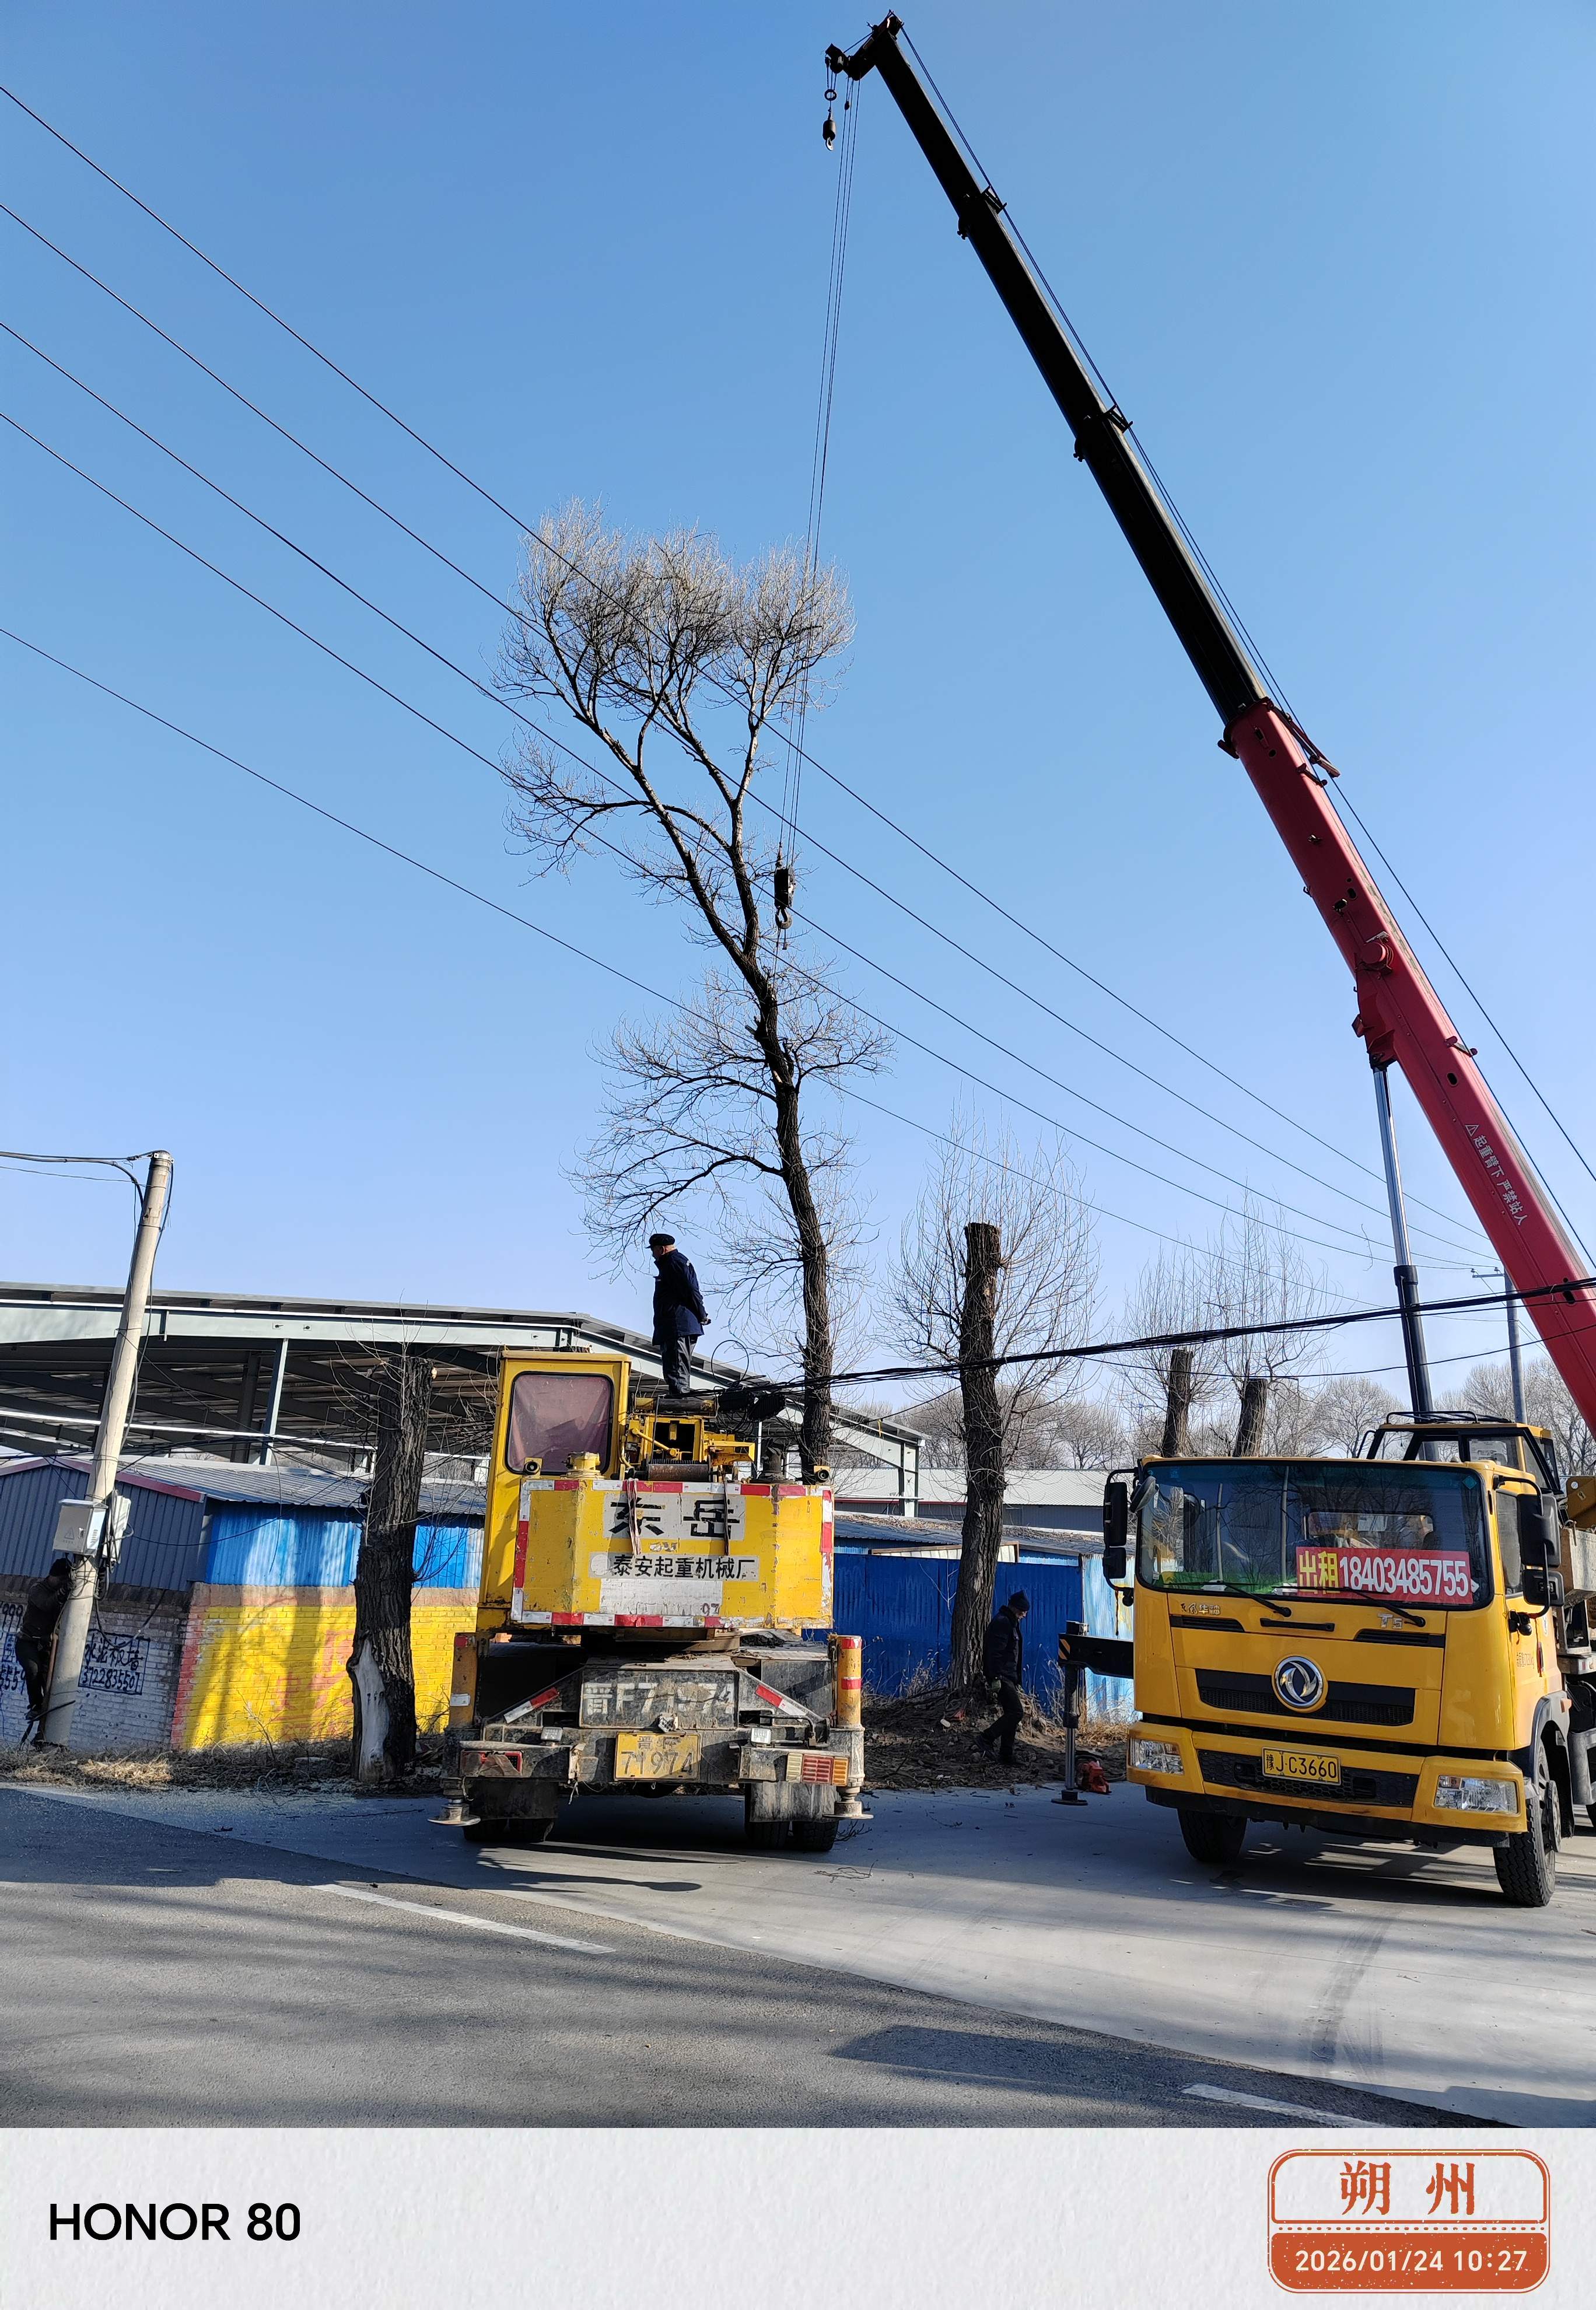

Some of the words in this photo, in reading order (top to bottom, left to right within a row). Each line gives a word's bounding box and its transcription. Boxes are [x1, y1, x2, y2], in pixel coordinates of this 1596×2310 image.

[1473, 1135, 1505, 1178] 起重臂下
[1496, 1179, 1528, 1226] 严禁站人
[612, 1553, 755, 1580] 泰安起重机械厂
[621, 1751, 693, 1775] 71974
